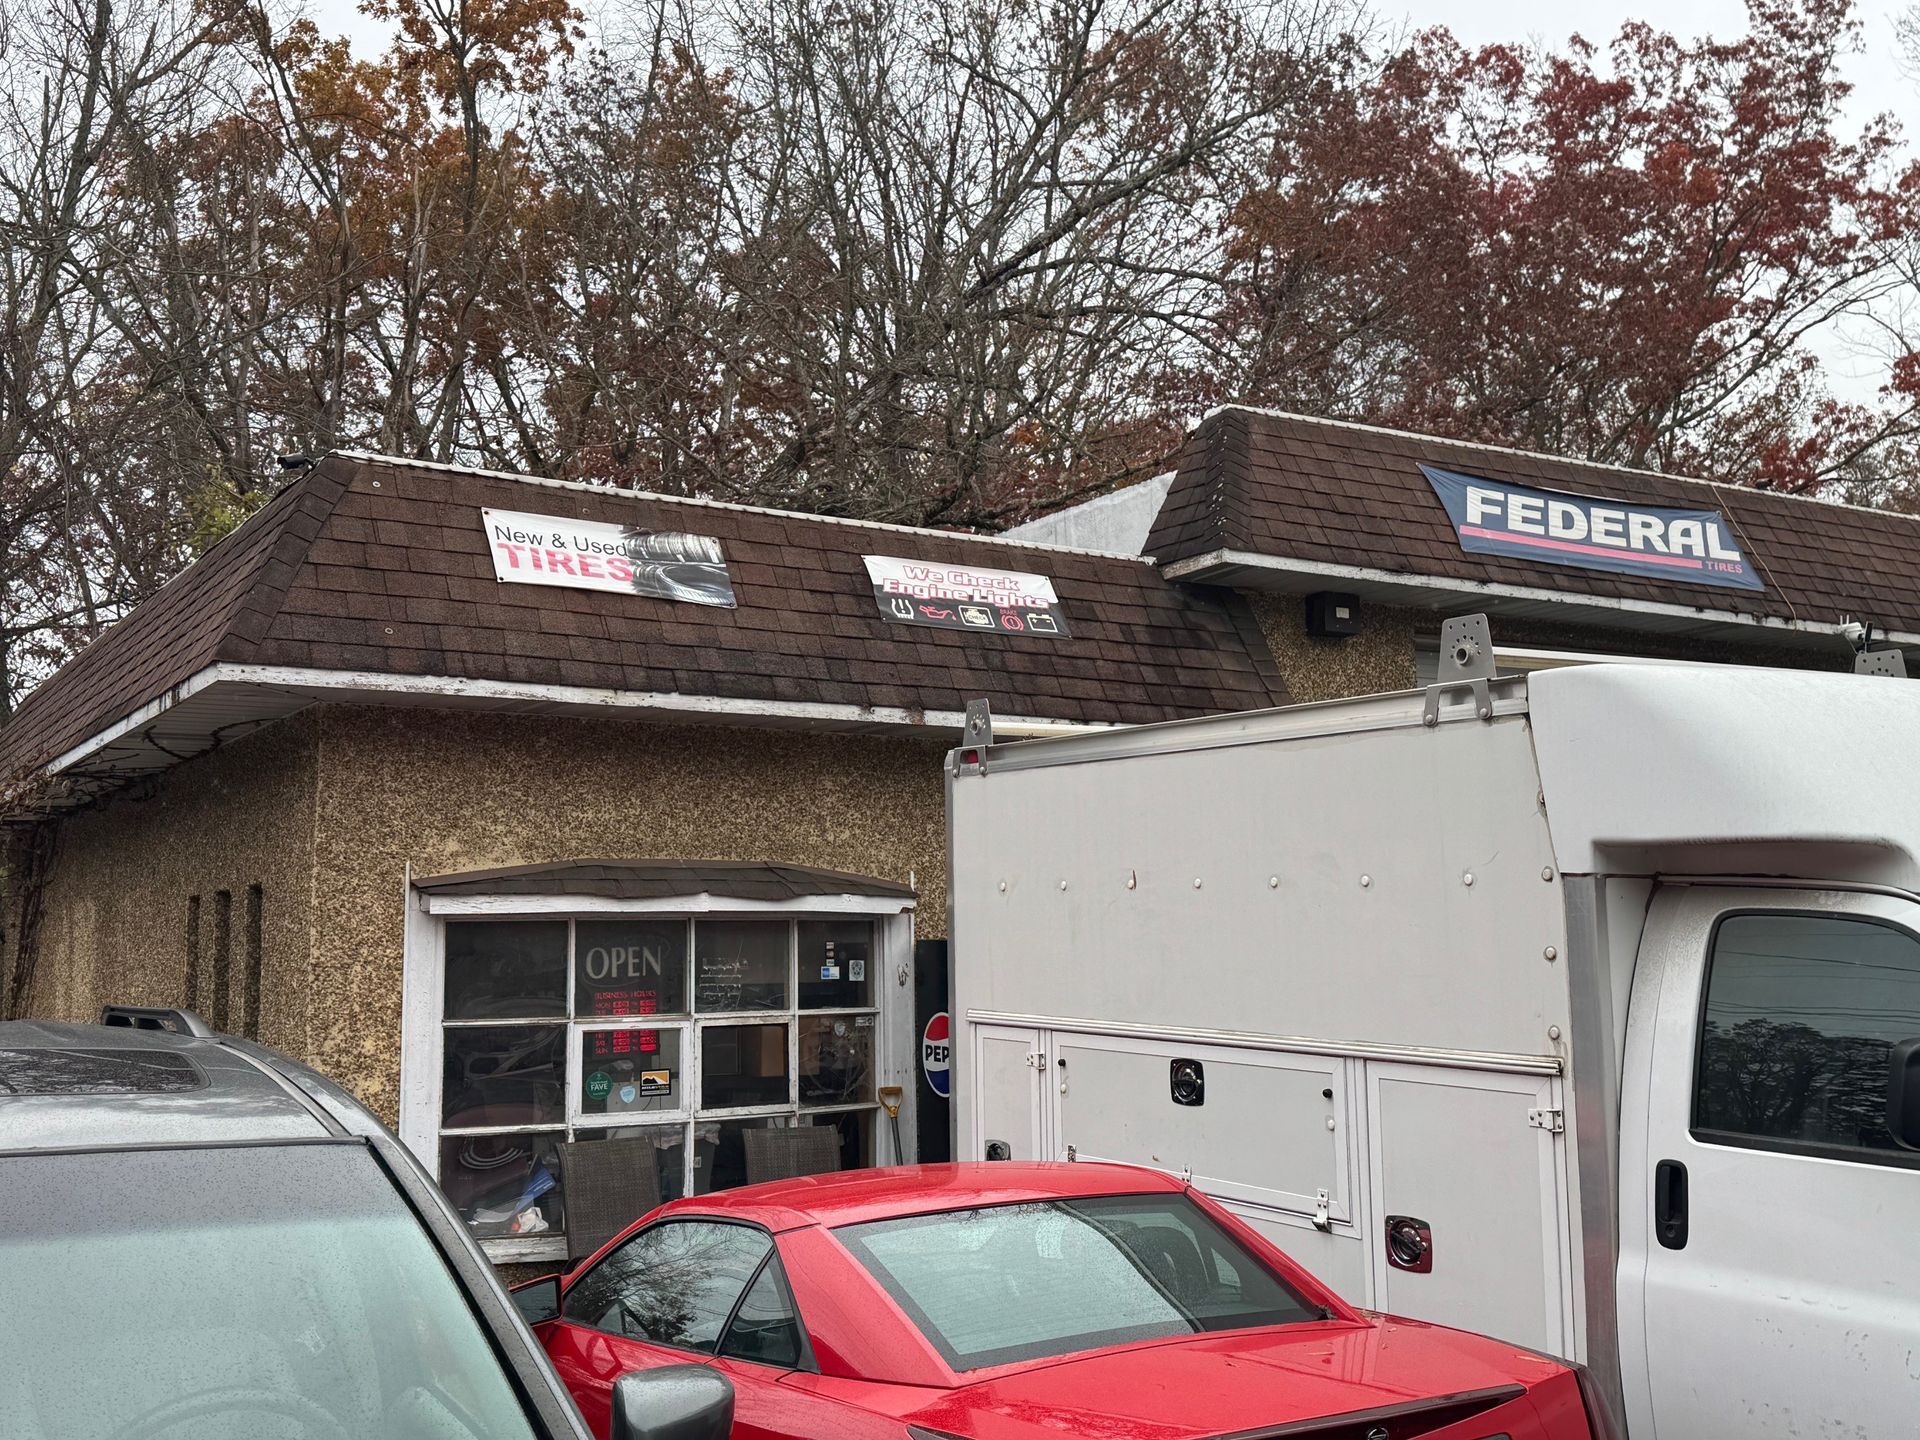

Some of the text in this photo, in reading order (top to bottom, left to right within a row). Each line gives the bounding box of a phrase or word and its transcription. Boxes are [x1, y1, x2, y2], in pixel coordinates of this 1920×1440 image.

[1465, 485, 1741, 562] FEDERAL
[494, 525, 628, 557] New & Used
[497, 543, 634, 582] TIRES
[903, 565, 1021, 592] We Check
[1707, 560, 1743, 574] TIRES
[883, 577, 1049, 609] Engine Lights
[968, 614, 987, 622] CHECK
[586, 946, 661, 979] OPEN
